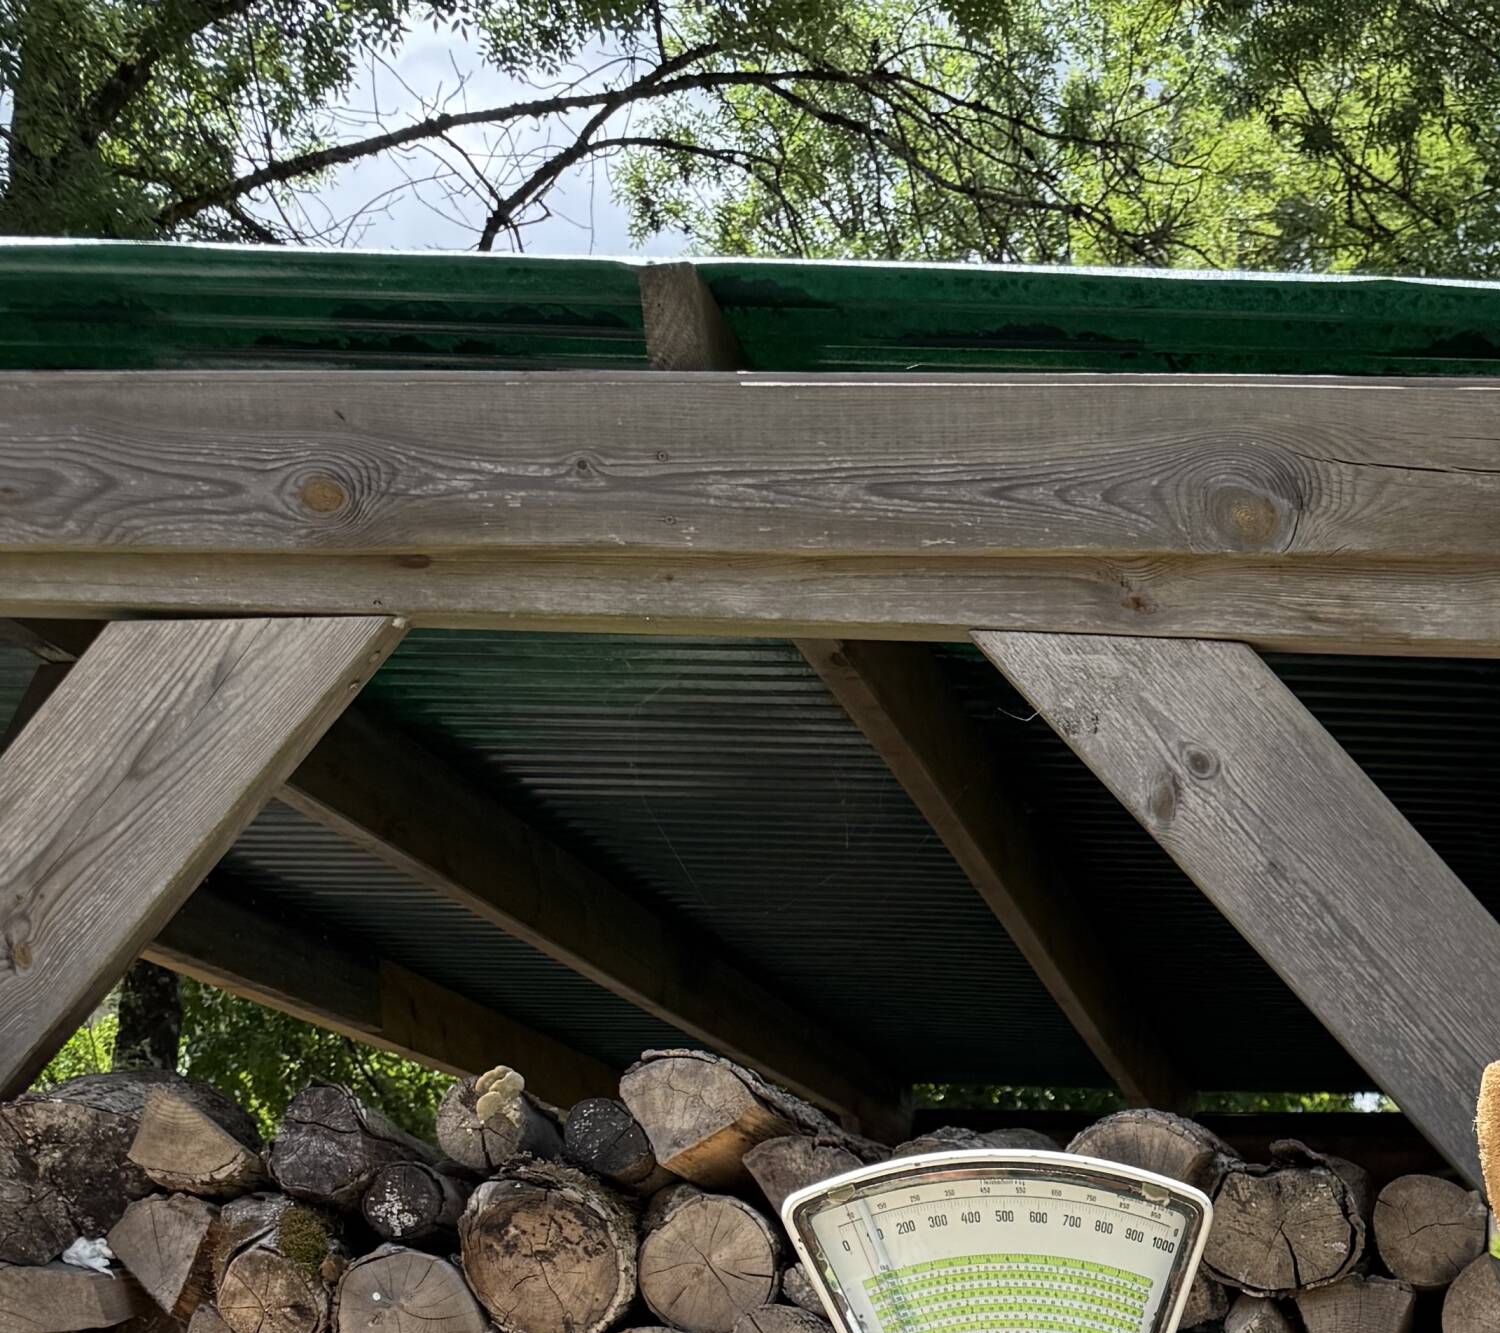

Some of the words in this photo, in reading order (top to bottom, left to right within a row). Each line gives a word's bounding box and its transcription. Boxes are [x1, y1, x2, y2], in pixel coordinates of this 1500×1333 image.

[842, 1240, 850, 1251] 0
[866, 1228, 884, 1244] 10
[896, 1220, 916, 1235] 200
[928, 1214, 948, 1228] 300
[961, 1211, 981, 1224] 400
[995, 1210, 1014, 1223] 500
[1029, 1211, 1048, 1224] 600
[1063, 1214, 1082, 1229] 700
[1094, 1219, 1113, 1235] 800
[1125, 1227, 1144, 1243] 900
[1152, 1236, 1175, 1254] 1000
